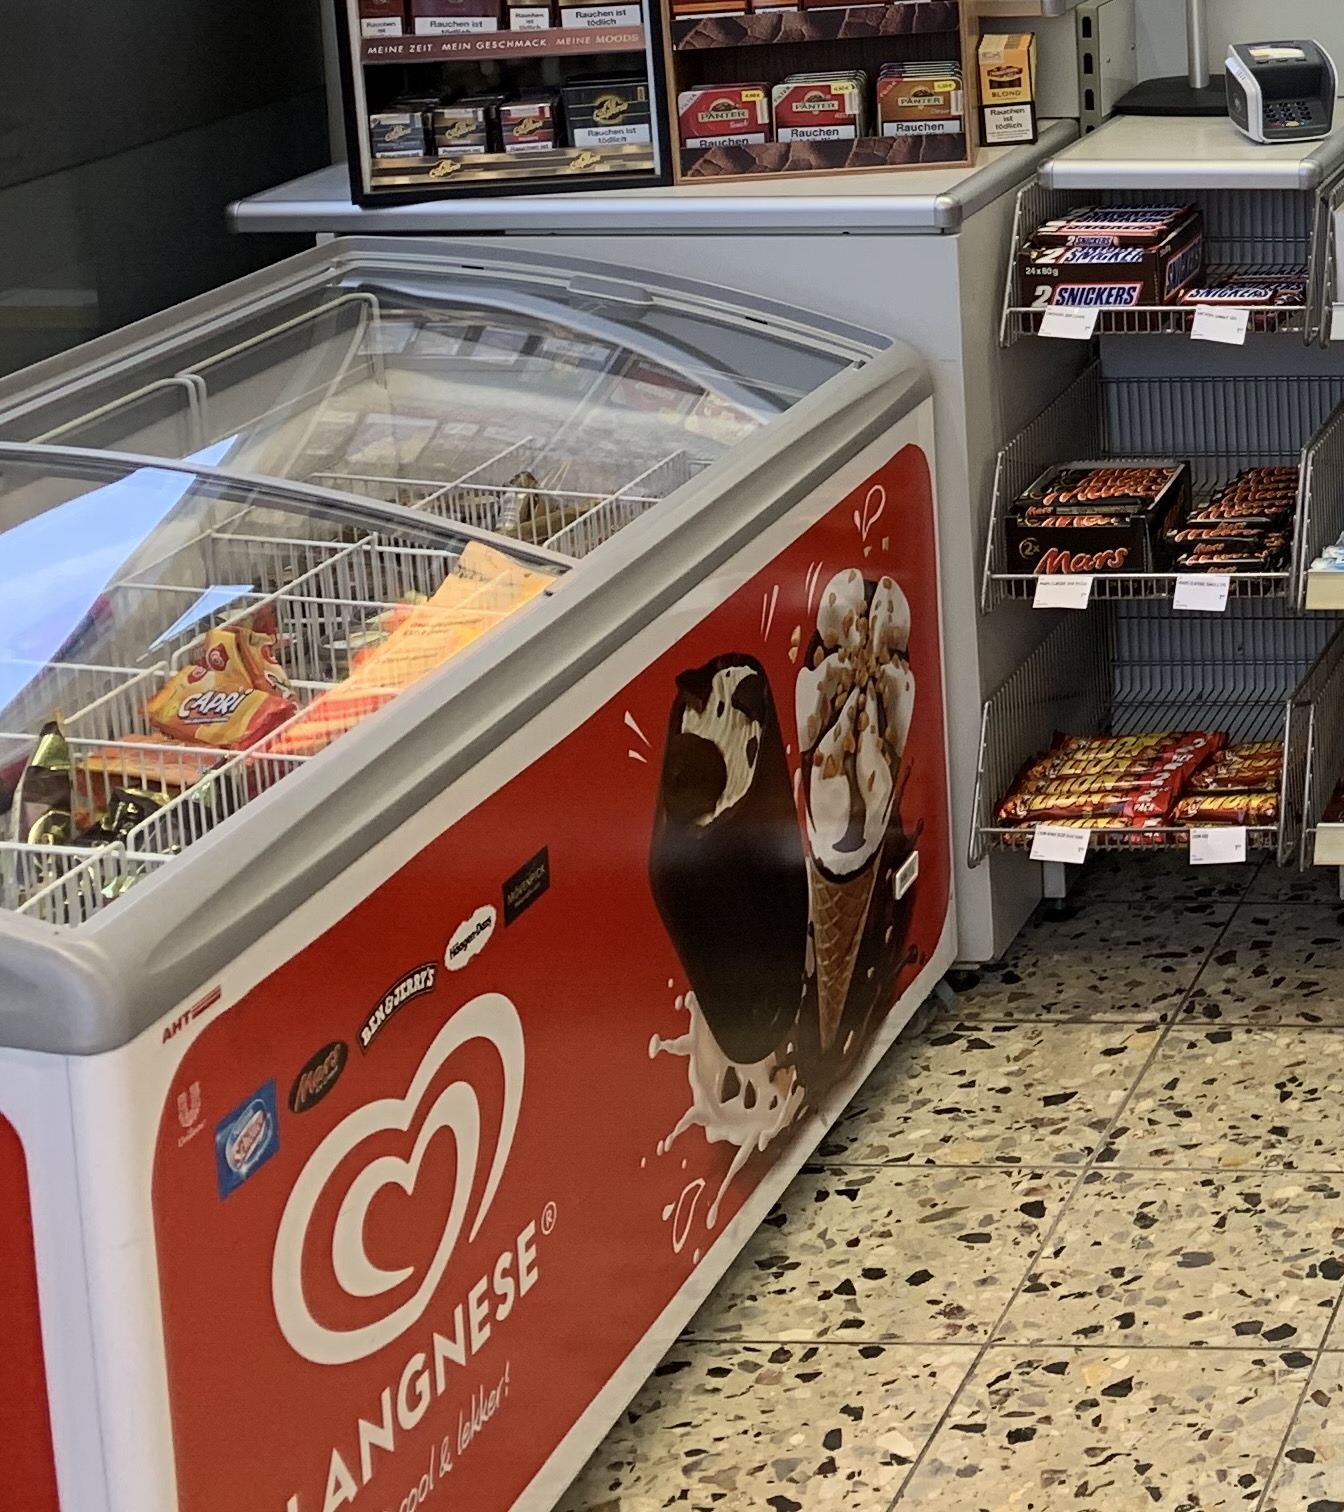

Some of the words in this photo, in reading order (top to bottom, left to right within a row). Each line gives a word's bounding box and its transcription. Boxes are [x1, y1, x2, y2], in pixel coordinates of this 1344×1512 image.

[576, 10, 610, 18] Rauchen
[612, 9, 626, 17] ist
[587, 18, 616, 26] tödlich
[1055, 287, 1135, 306] SNICKERS
[1035, 545, 1128, 574] Mars
[178, 691, 244, 722] CAPRI
[361, 1014, 385, 1047] BEN
[384, 997, 396, 1016] &
[287, 1219, 539, 1512] ANGNESE
[457, 1361, 510, 1455] lekker!
